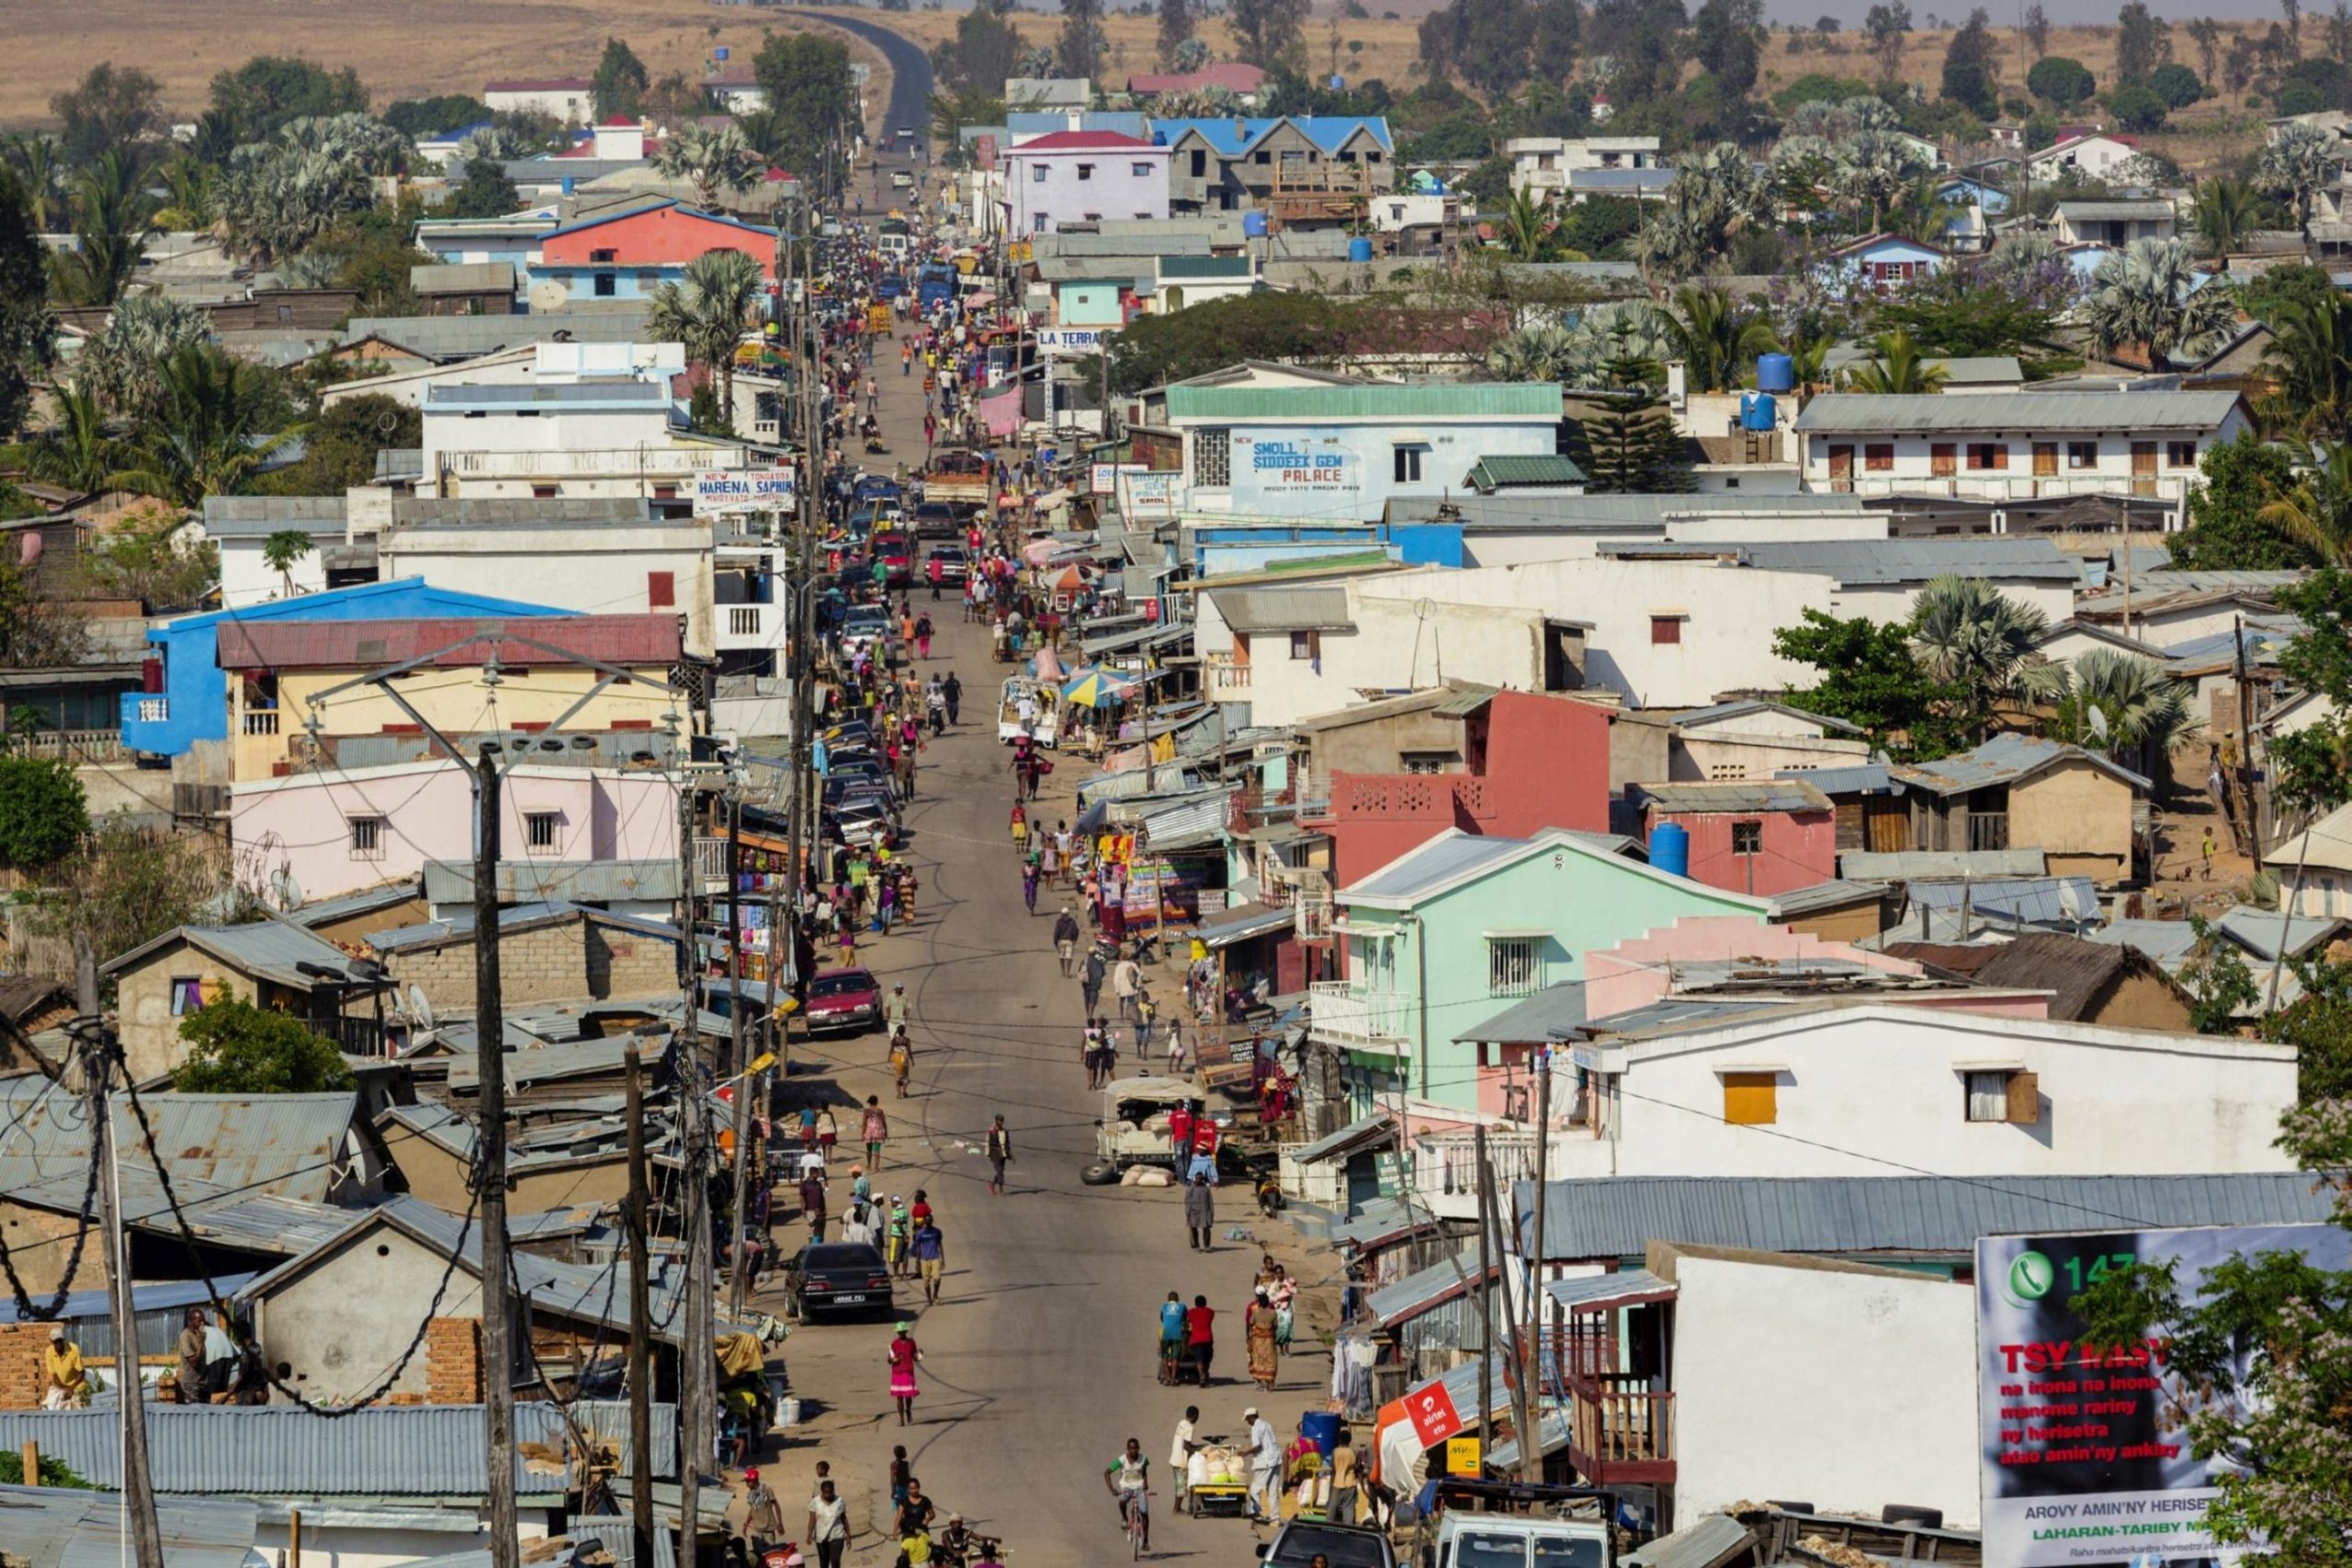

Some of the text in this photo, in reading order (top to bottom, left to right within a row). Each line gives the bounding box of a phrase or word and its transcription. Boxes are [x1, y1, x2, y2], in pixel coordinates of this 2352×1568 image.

[1039, 332, 1102, 344] LA TERRA
[1253, 442, 1297, 455] SMOLL
[1253, 455, 1342, 468] SIDDEEK GEM
[706, 472, 728, 481] NEW
[1283, 468, 1341, 482] PALACE
[699, 480, 794, 494] HARENA SAPHIR
[2000, 1341, 2072, 1373] TSY
[2001, 1384, 2023, 1397] na
[2028, 1380, 2077, 1395] inona
[2083, 1379, 2104, 1392] na
[1423, 1408, 1447, 1427] airtel
[2001, 1398, 2137, 1419] manome rariny
[2000, 1423, 2109, 1443] ny herisetra
[2000, 1441, 2180, 1465] atao amin'ny ankizy
[2025, 1504, 2077, 1519] AROVY
[2082, 1500, 2147, 1517] AMIN'NY
[2033, 1521, 2181, 1540] LAHARAN-TARIBY
[2070, 1548, 2095, 1557] Raha
